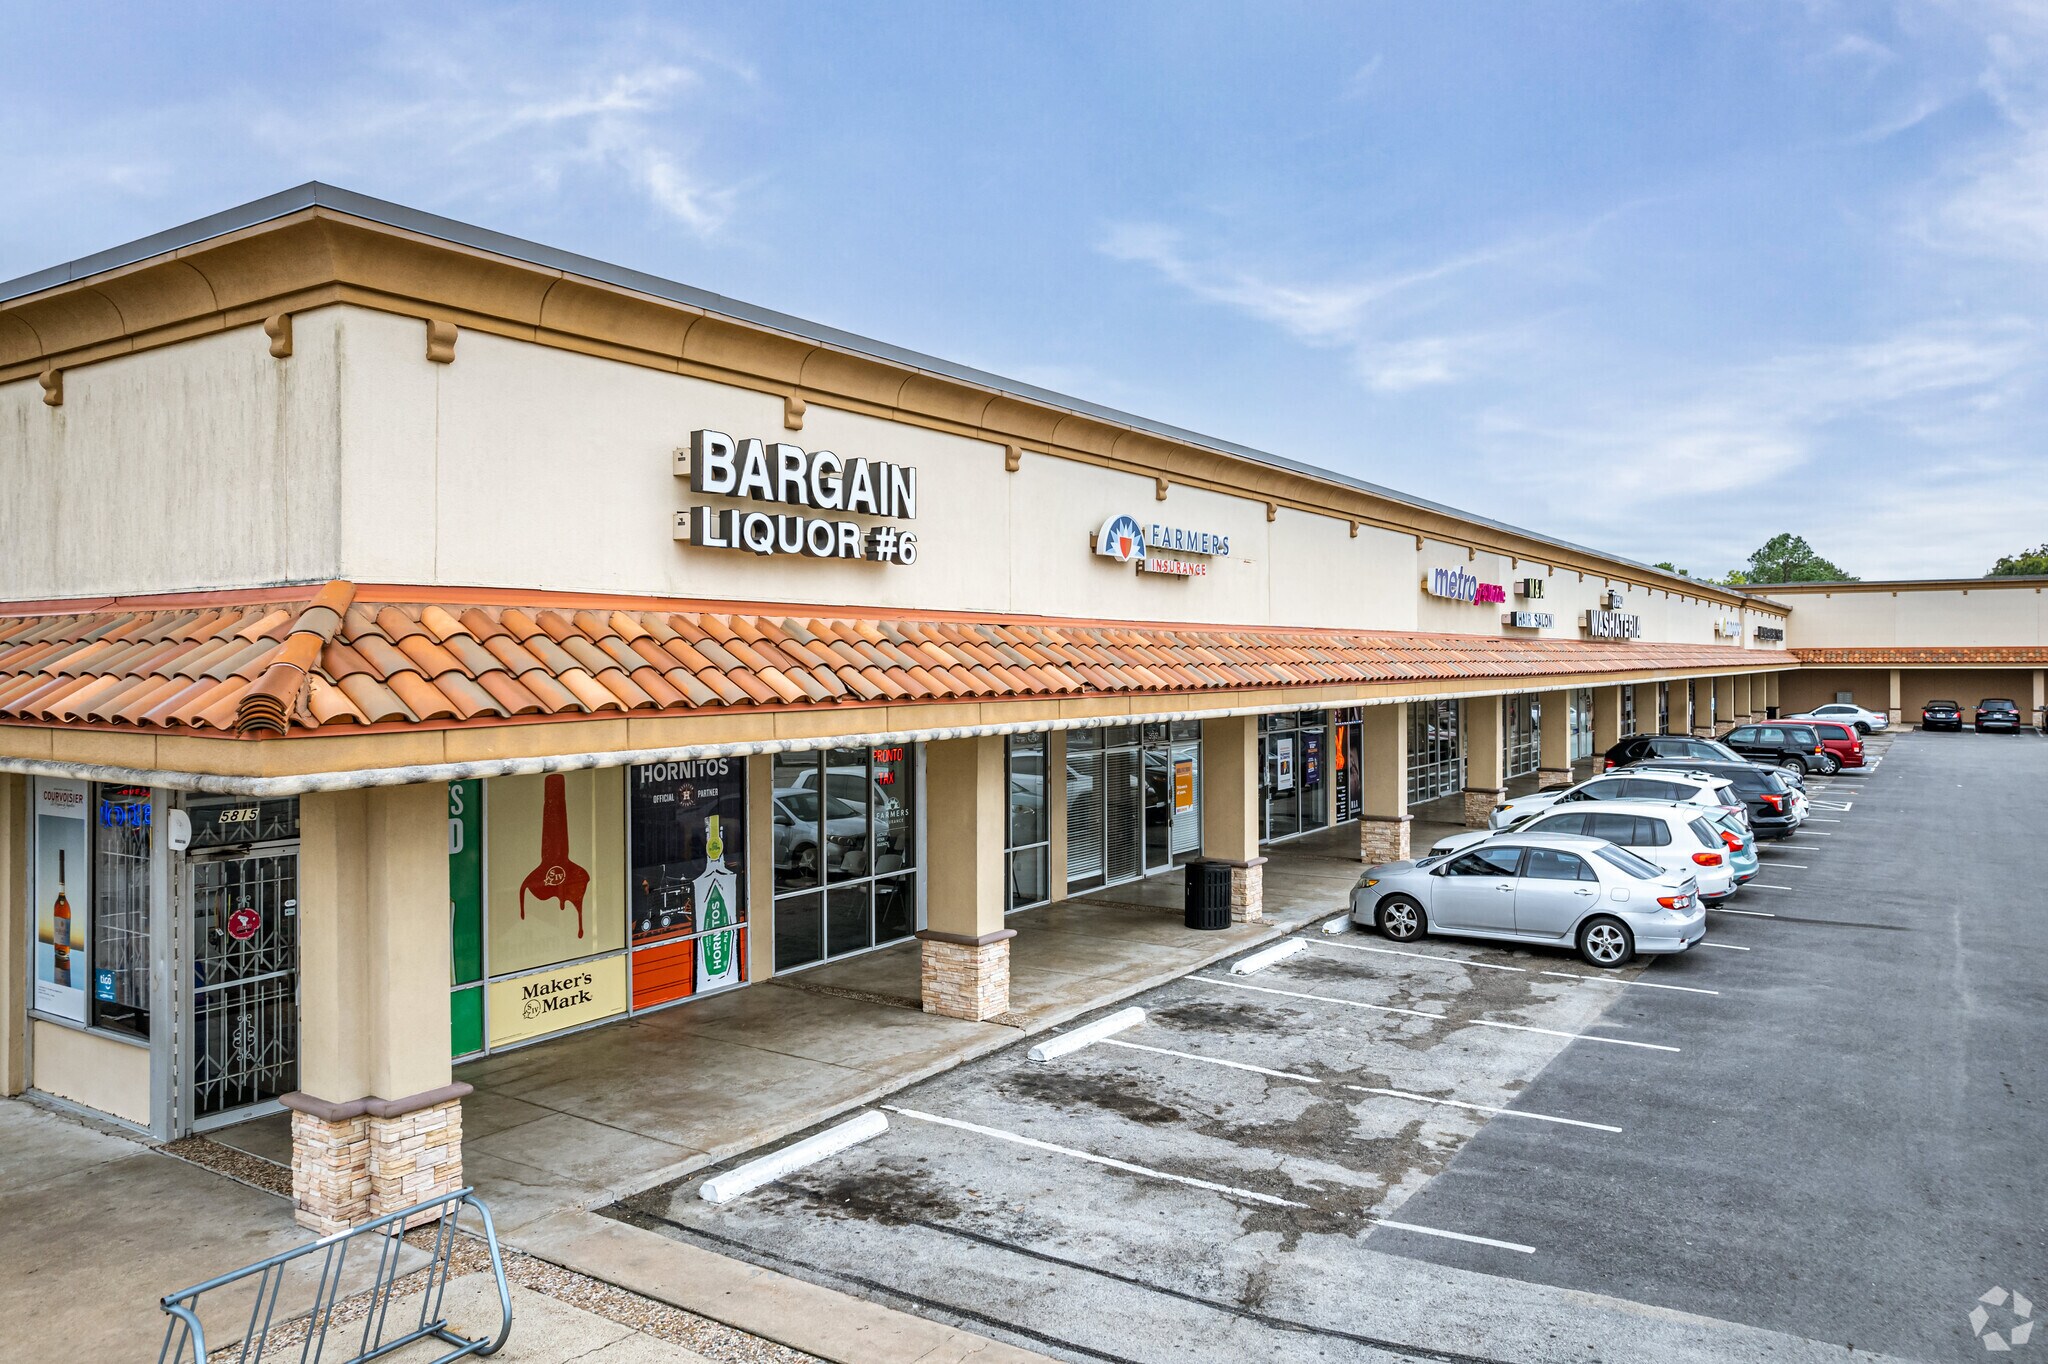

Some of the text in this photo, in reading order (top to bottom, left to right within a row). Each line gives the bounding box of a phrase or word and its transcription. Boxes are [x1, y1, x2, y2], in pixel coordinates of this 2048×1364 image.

[697, 429, 917, 519] BARGAIN
[697, 506, 917, 565] LIQUOR #6
[1152, 524, 1229, 556] FARMERS
[1152, 559, 1206, 576] INSURANCE
[1434, 566, 1477, 602] metro
[1518, 611, 1553, 628] HAIR SALON
[1590, 609, 1641, 639] WASHATERIA
[873, 747, 903, 763] PRONTO
[640, 757, 729, 784] HORNITOS
[879, 772, 895, 785] TAX
[43, 790, 84, 804] COURVOISIER
[652, 793, 675, 804] OFFICIAL
[697, 787, 719, 798] PARTNER
[220, 808, 259, 822] 5815
[876, 808, 909, 820] FARMERS
[711, 900, 722, 970] HORNTOS
[521, 972, 593, 1001] Maker's
[541, 989, 592, 1014] Mark
